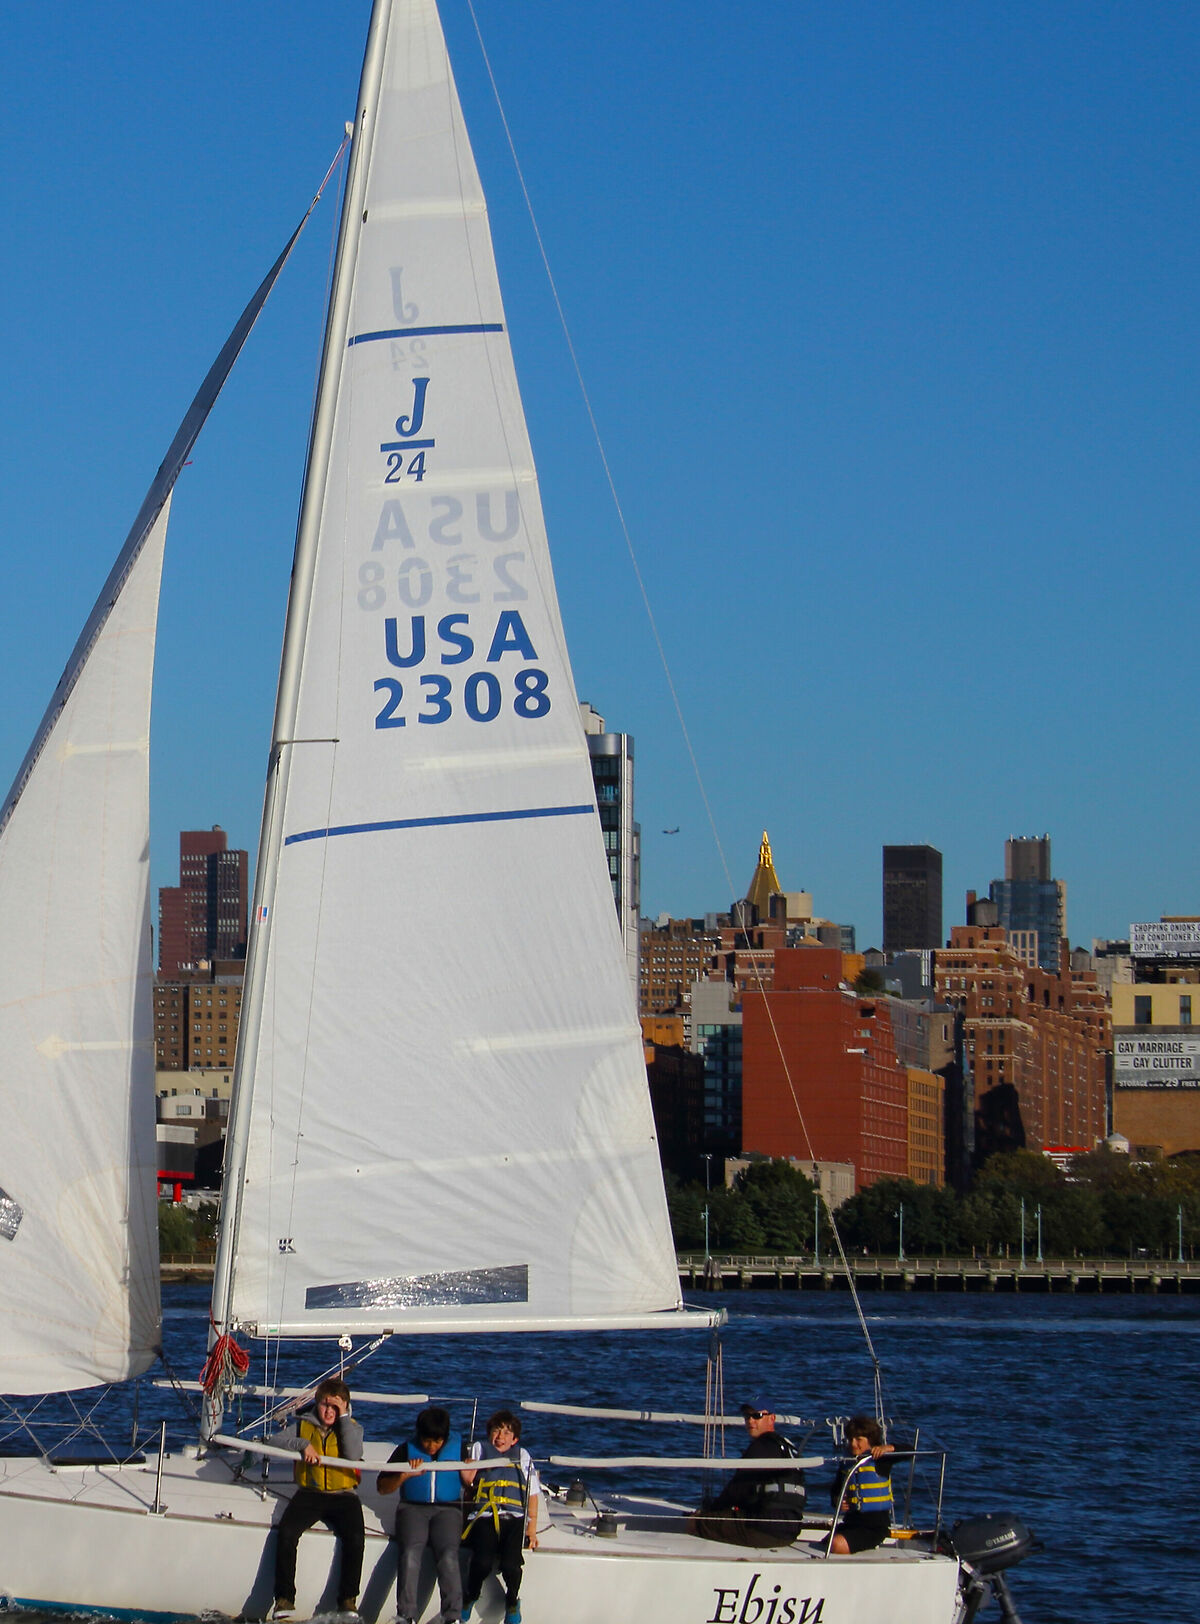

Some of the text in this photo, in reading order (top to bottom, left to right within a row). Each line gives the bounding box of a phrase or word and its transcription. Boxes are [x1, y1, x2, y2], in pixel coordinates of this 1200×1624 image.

[395, 377, 431, 438] J
[384, 451, 427, 484] 24
[384, 610, 539, 669] USA
[373, 668, 552, 730] 2308
[1134, 923, 1169, 932] CHOPPING
[1170, 923, 1196, 932] ONIONS
[1134, 933, 1145, 941] AIR
[1147, 933, 1192, 941] CONDITIONER
[1118, 1042, 1135, 1053] GAY
[1137, 1042, 1184, 1054] MARRIAGE
[1133, 1057, 1150, 1068] GAY
[1152, 1057, 1192, 1069] CLUTTER
[992, 1529, 1016, 1545] YAMAHA
